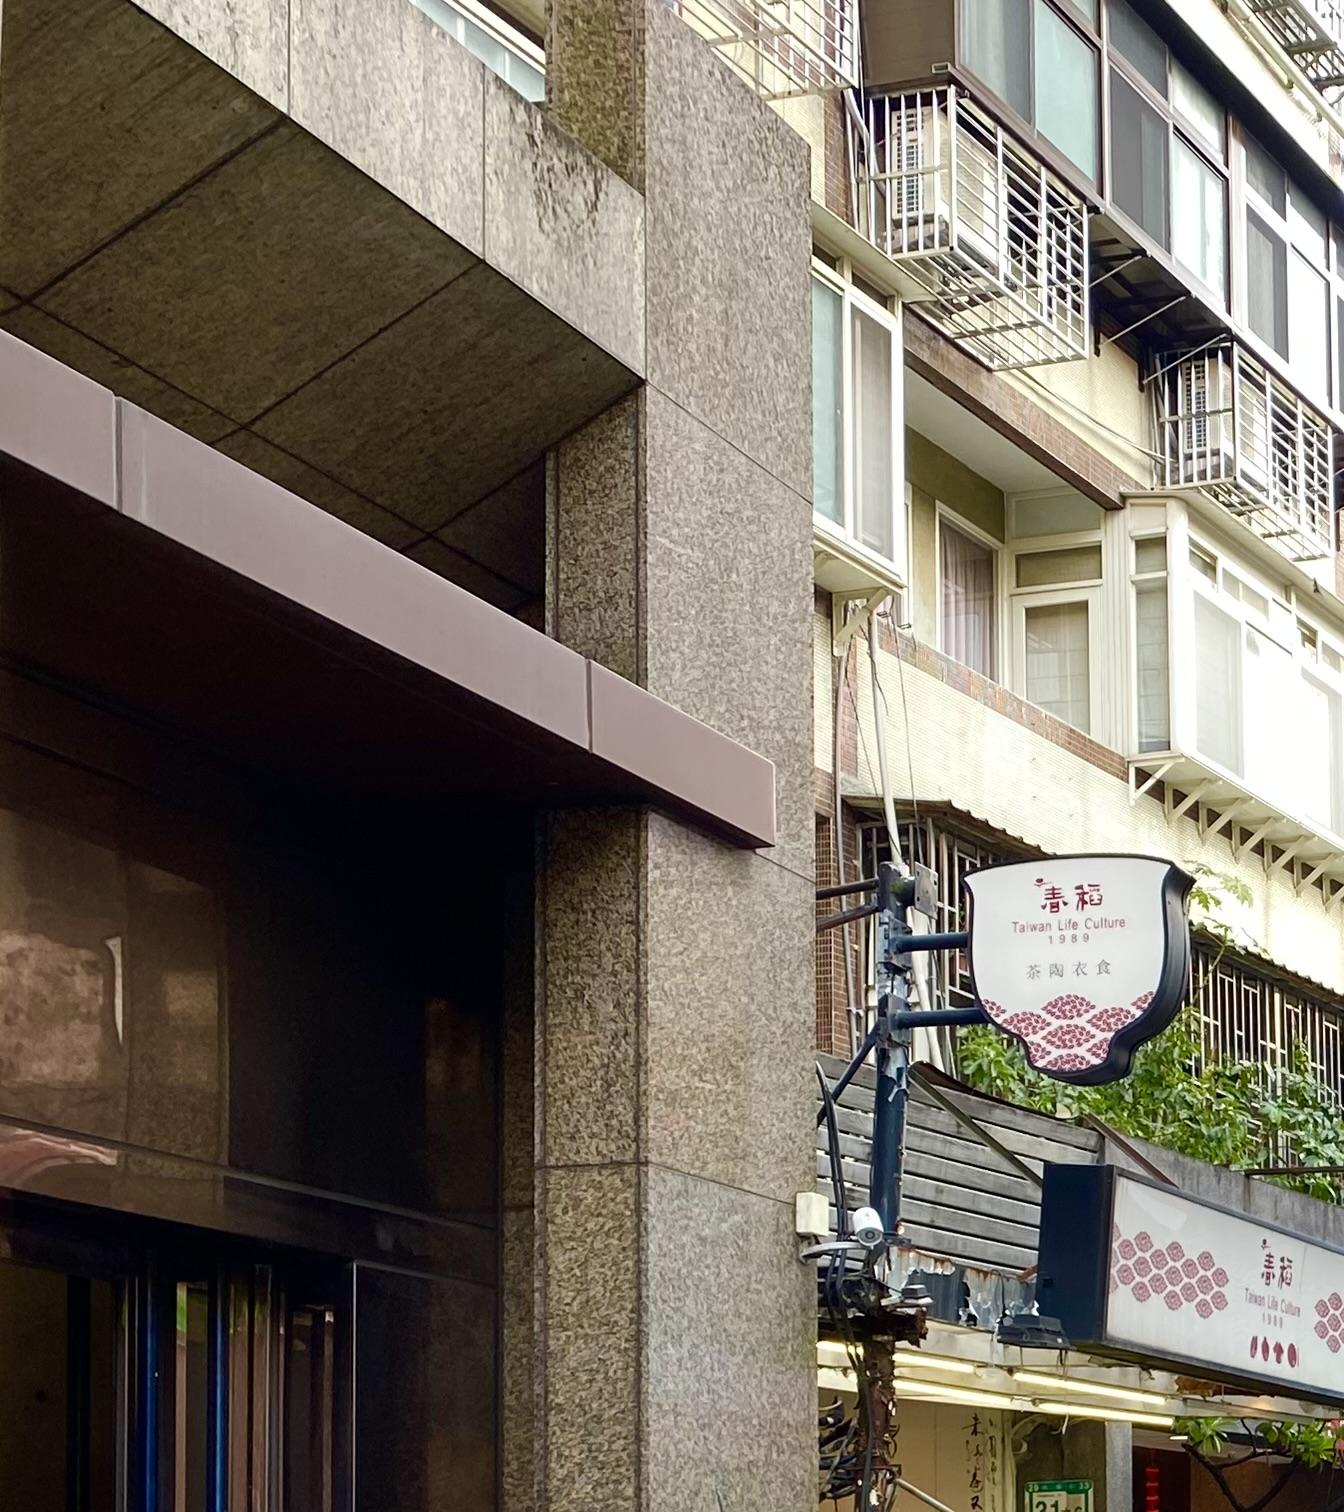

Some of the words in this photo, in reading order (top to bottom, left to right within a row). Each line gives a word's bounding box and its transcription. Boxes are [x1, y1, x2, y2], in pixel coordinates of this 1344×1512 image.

[1012, 921, 1052, 933] Taiwan
[1058, 918, 1078, 931] Life
[1084, 917, 1126, 930] Culture
[1048, 933, 1090, 944] 1989
[1026, 959, 1111, 980] 茶陶衣食
